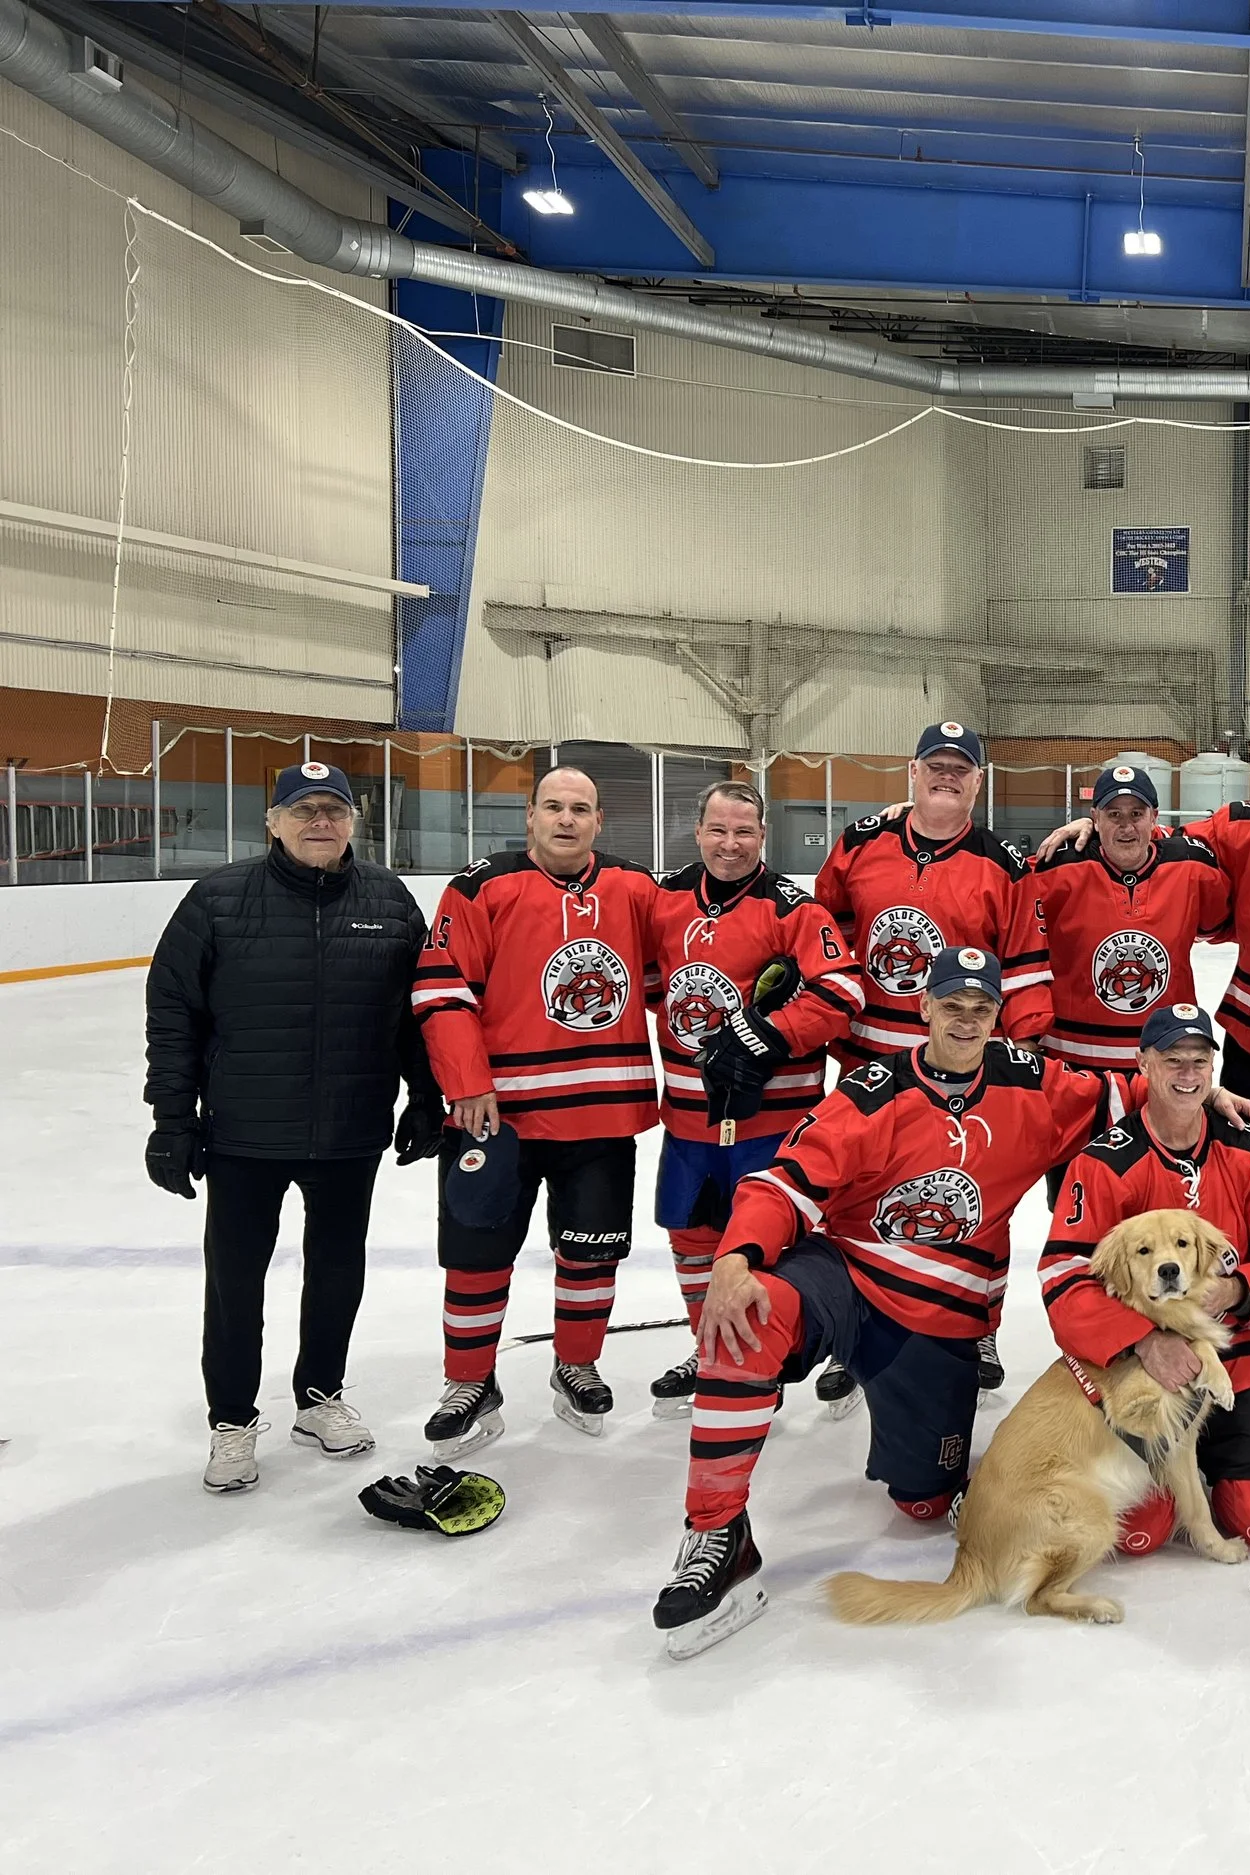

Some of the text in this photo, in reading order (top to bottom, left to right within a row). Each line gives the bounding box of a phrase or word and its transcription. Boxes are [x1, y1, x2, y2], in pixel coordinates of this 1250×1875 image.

[422, 913, 453, 951] 15
[819, 925, 842, 961] 6
[872, 911, 941, 949] THE OLDE CRABS
[548, 943, 622, 978] THE OLDE CRABS
[1098, 934, 1165, 964] THE OLDE CRABS
[685, 966, 706, 979] OLDE
[708, 973, 736, 1002] CRABS
[786, 1111, 818, 1148] 7
[955, 1177, 977, 1212] CRABS
[1065, 1180, 1085, 1227] 3
[1063, 1352, 1096, 1396] IN TRAIN
